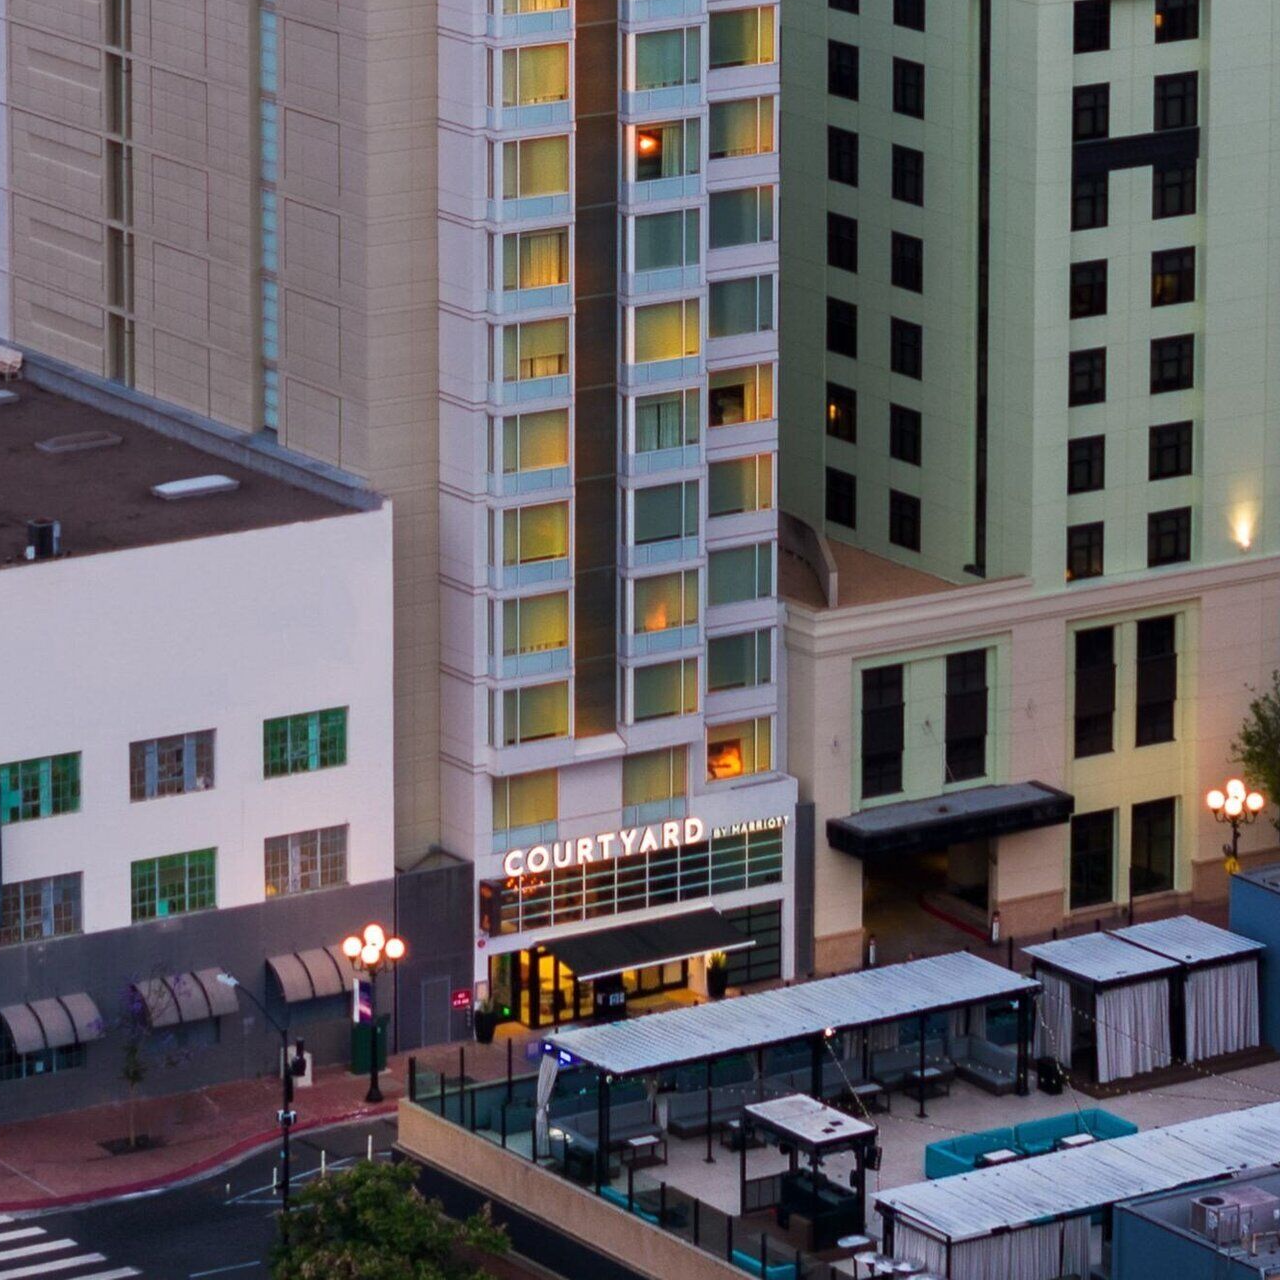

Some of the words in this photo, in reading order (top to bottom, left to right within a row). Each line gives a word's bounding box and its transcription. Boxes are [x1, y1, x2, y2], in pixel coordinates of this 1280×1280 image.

[504, 817, 704, 877] COURTYARD
[711, 826, 728, 839] BY
[731, 815, 789, 836] MARRIOTT
